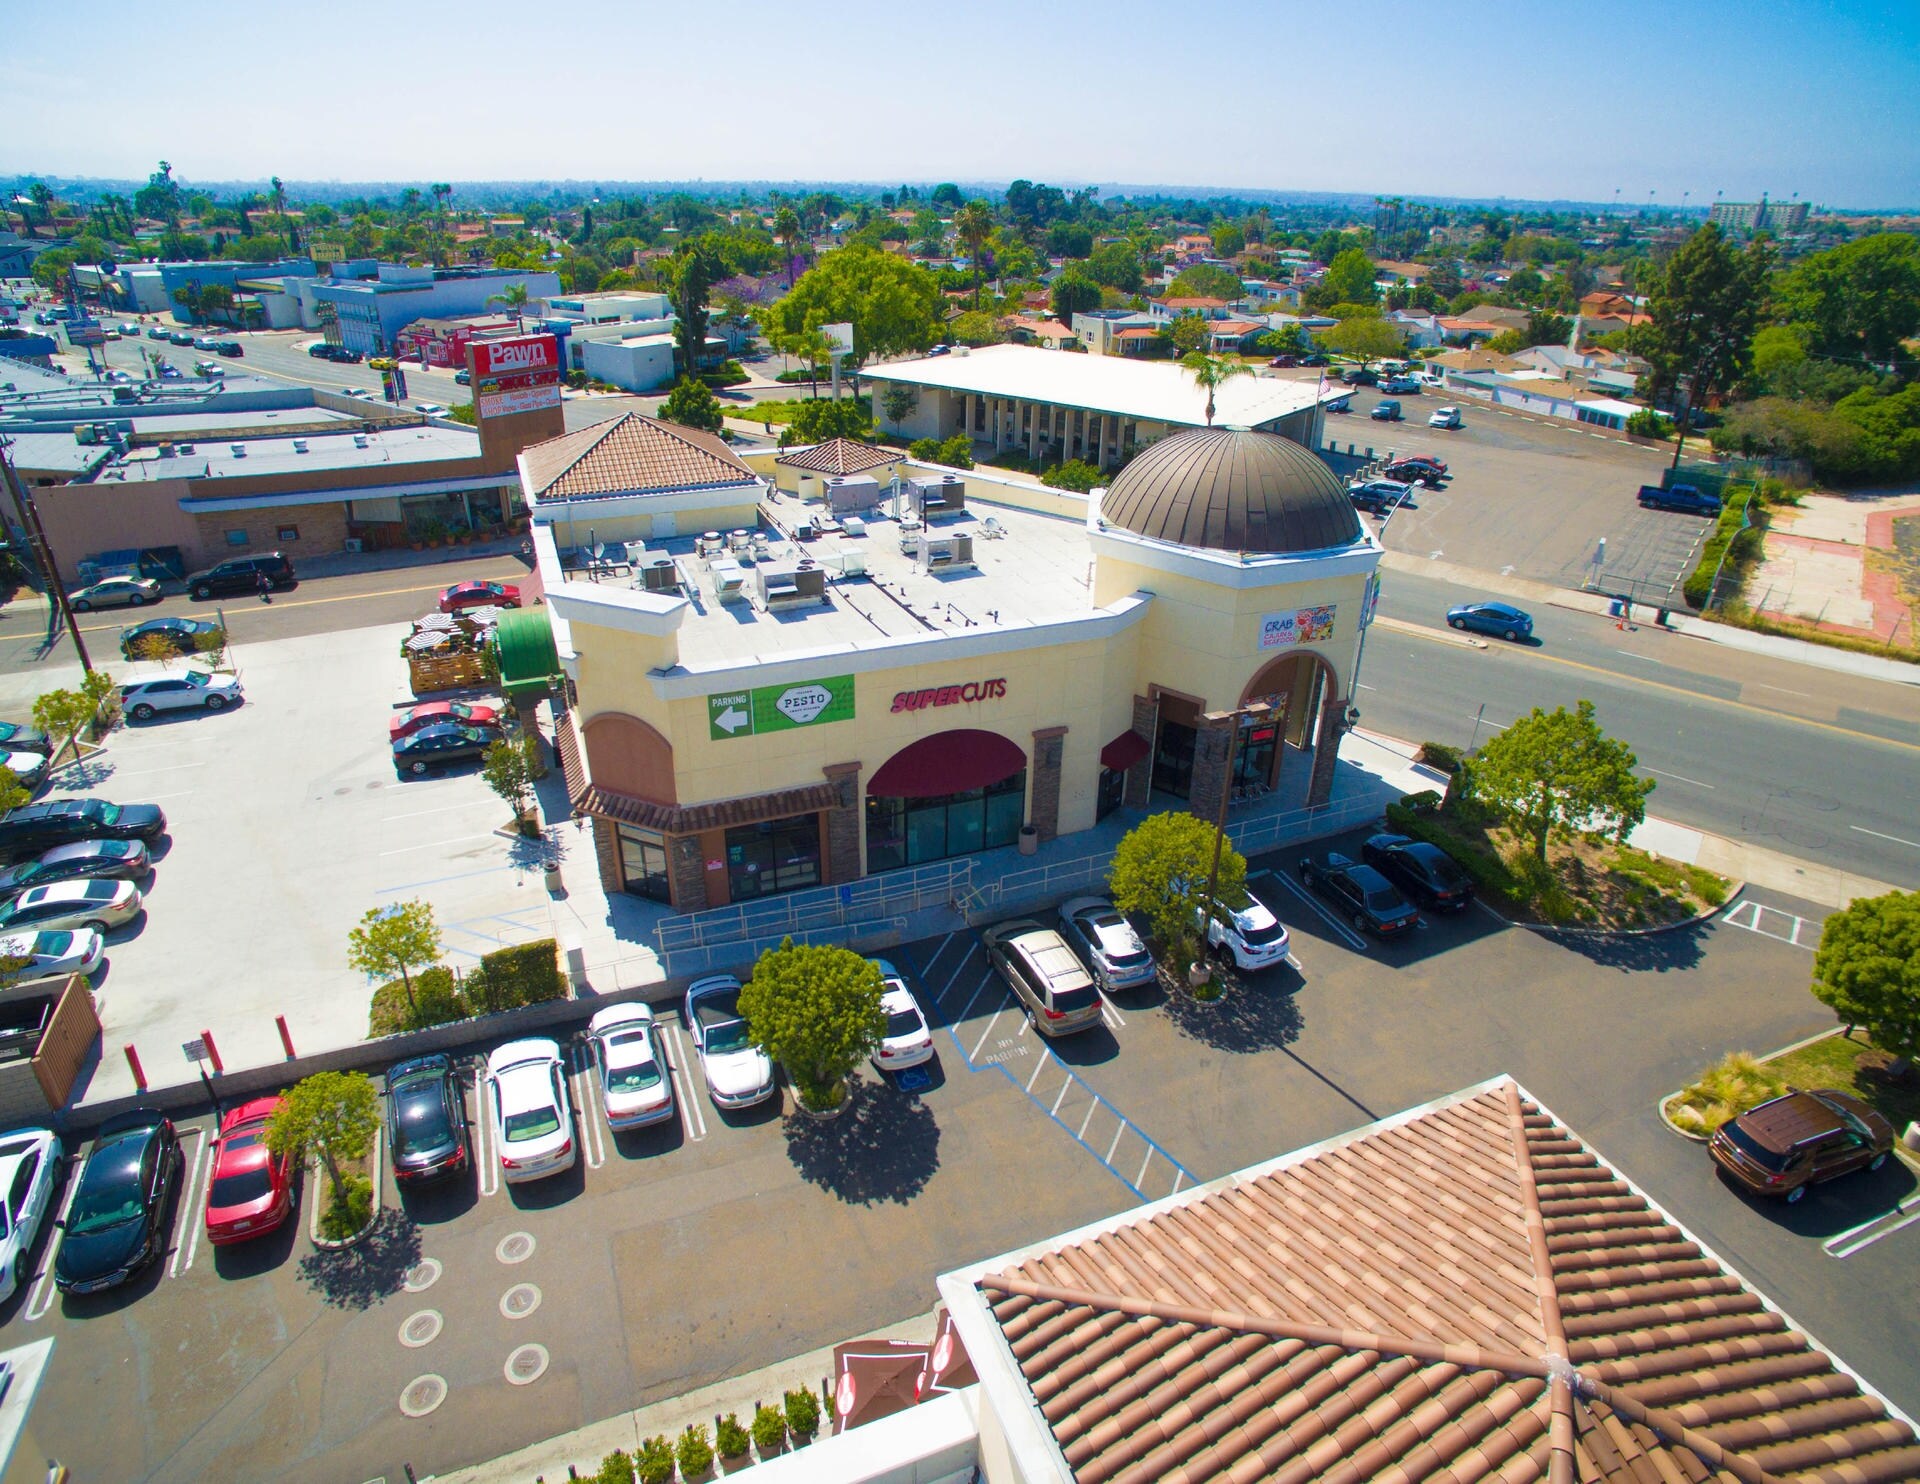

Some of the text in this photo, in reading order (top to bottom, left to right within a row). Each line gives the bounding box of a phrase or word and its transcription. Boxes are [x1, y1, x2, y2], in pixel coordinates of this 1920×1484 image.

[488, 343, 545, 365] Pawn
[1265, 619, 1294, 632] CRAB
[712, 694, 747, 707] PARKING
[784, 694, 825, 708] PESTO
[890, 678, 1006, 713] SUPERCUTS
